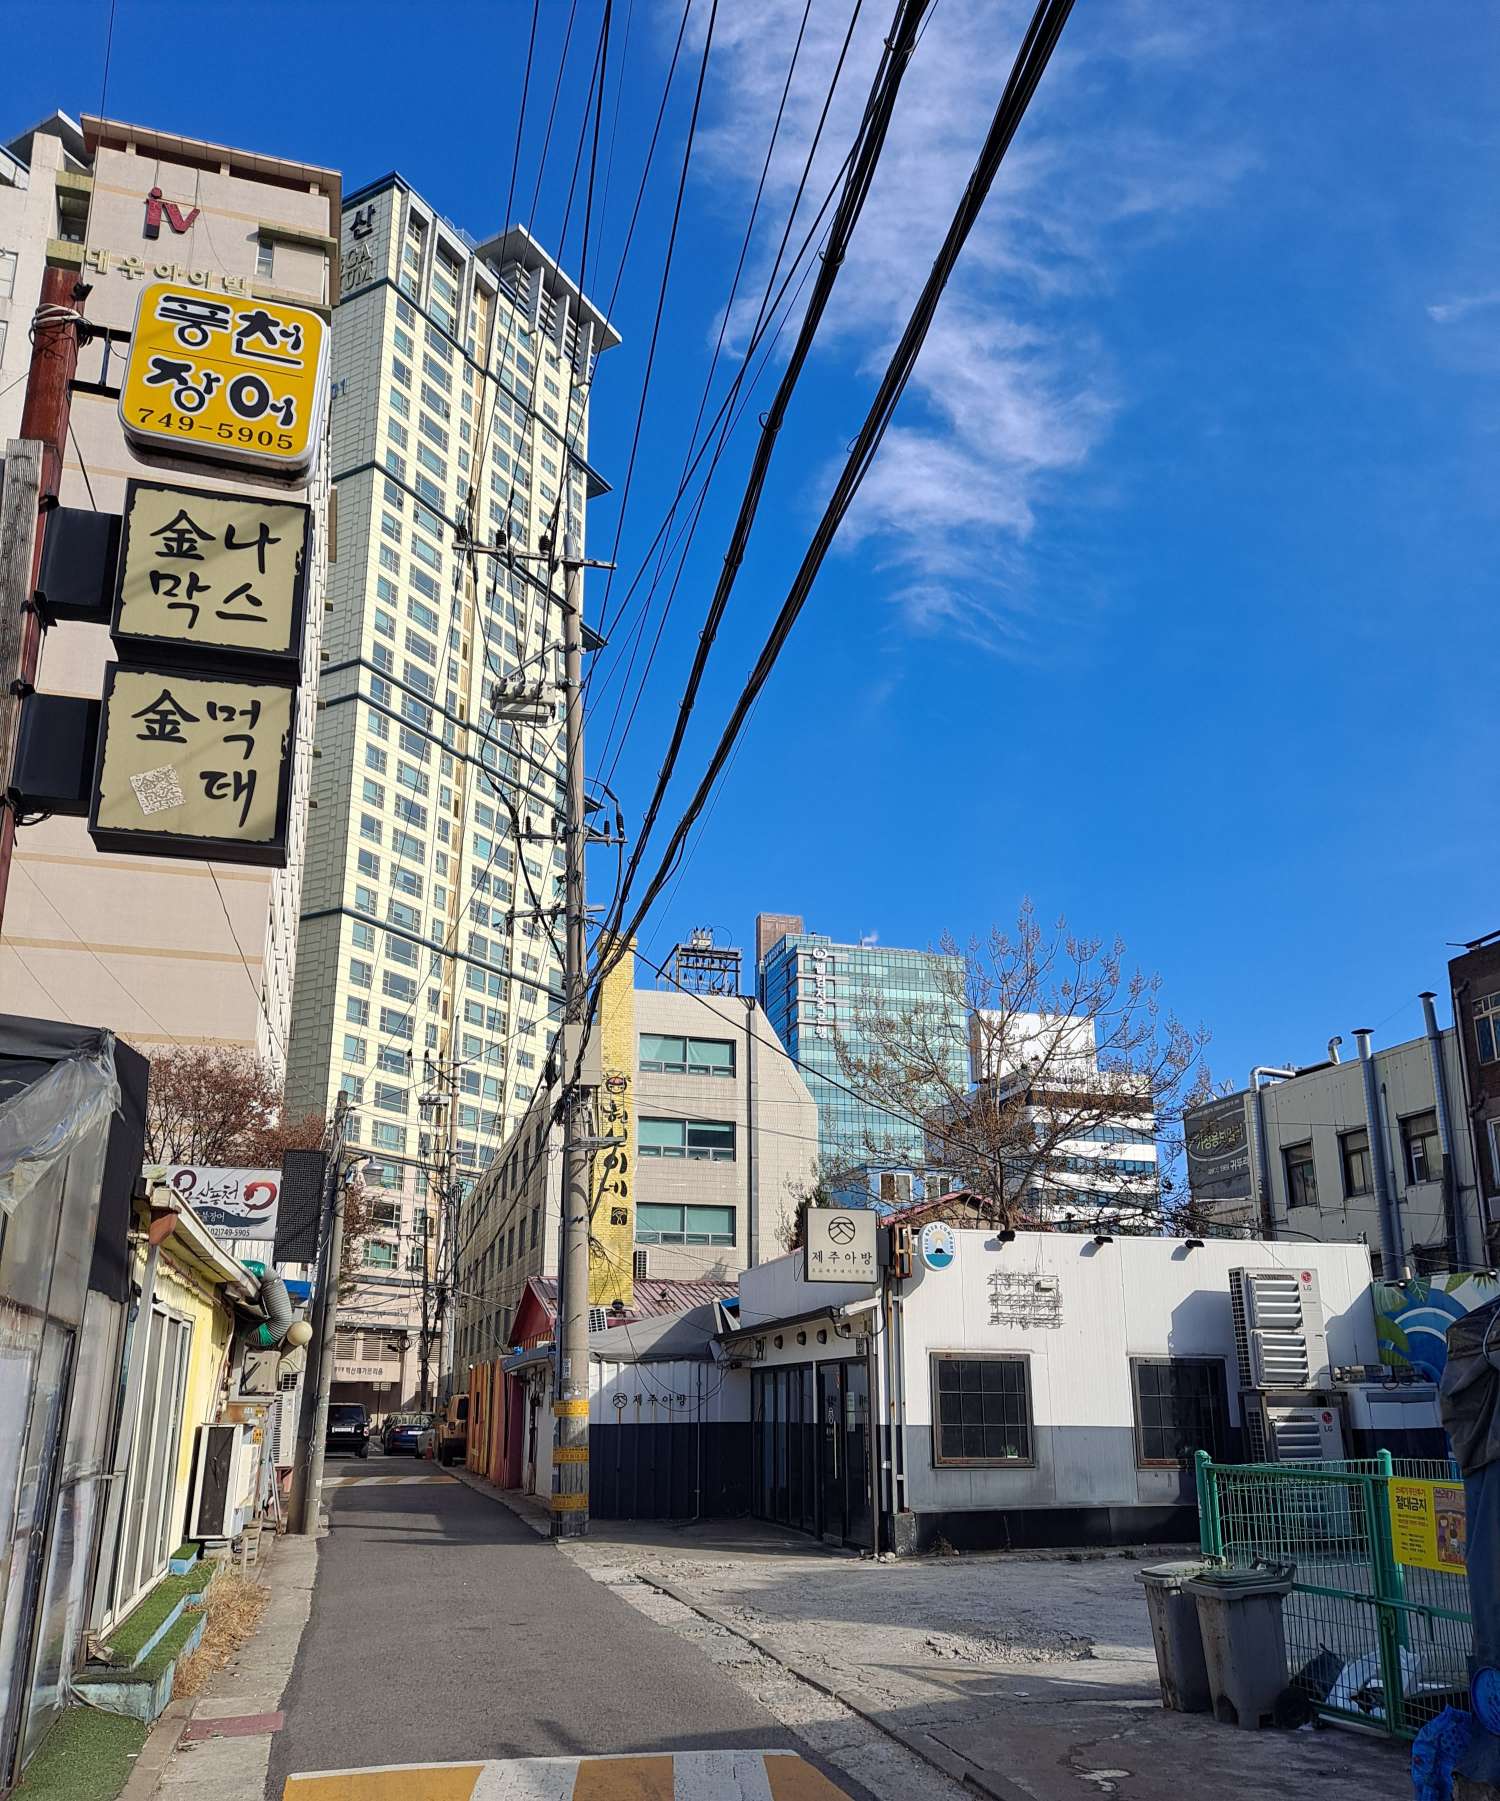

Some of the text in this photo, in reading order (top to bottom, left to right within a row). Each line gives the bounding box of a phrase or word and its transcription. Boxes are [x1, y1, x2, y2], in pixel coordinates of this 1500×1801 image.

[158, 294, 302, 367] 풍천
[145, 357, 294, 426] 장어
[137, 407, 294, 450] 749-5905
[150, 509, 281, 574] 金나
[149, 569, 268, 629] 막스
[131, 689, 261, 760] 金먹
[199, 768, 257, 828] 태
[811, 1250, 872, 1266] 제주아방
[633, 1393, 688, 1408] 제주아방
[1395, 1495, 1427, 1513] 절대금지
